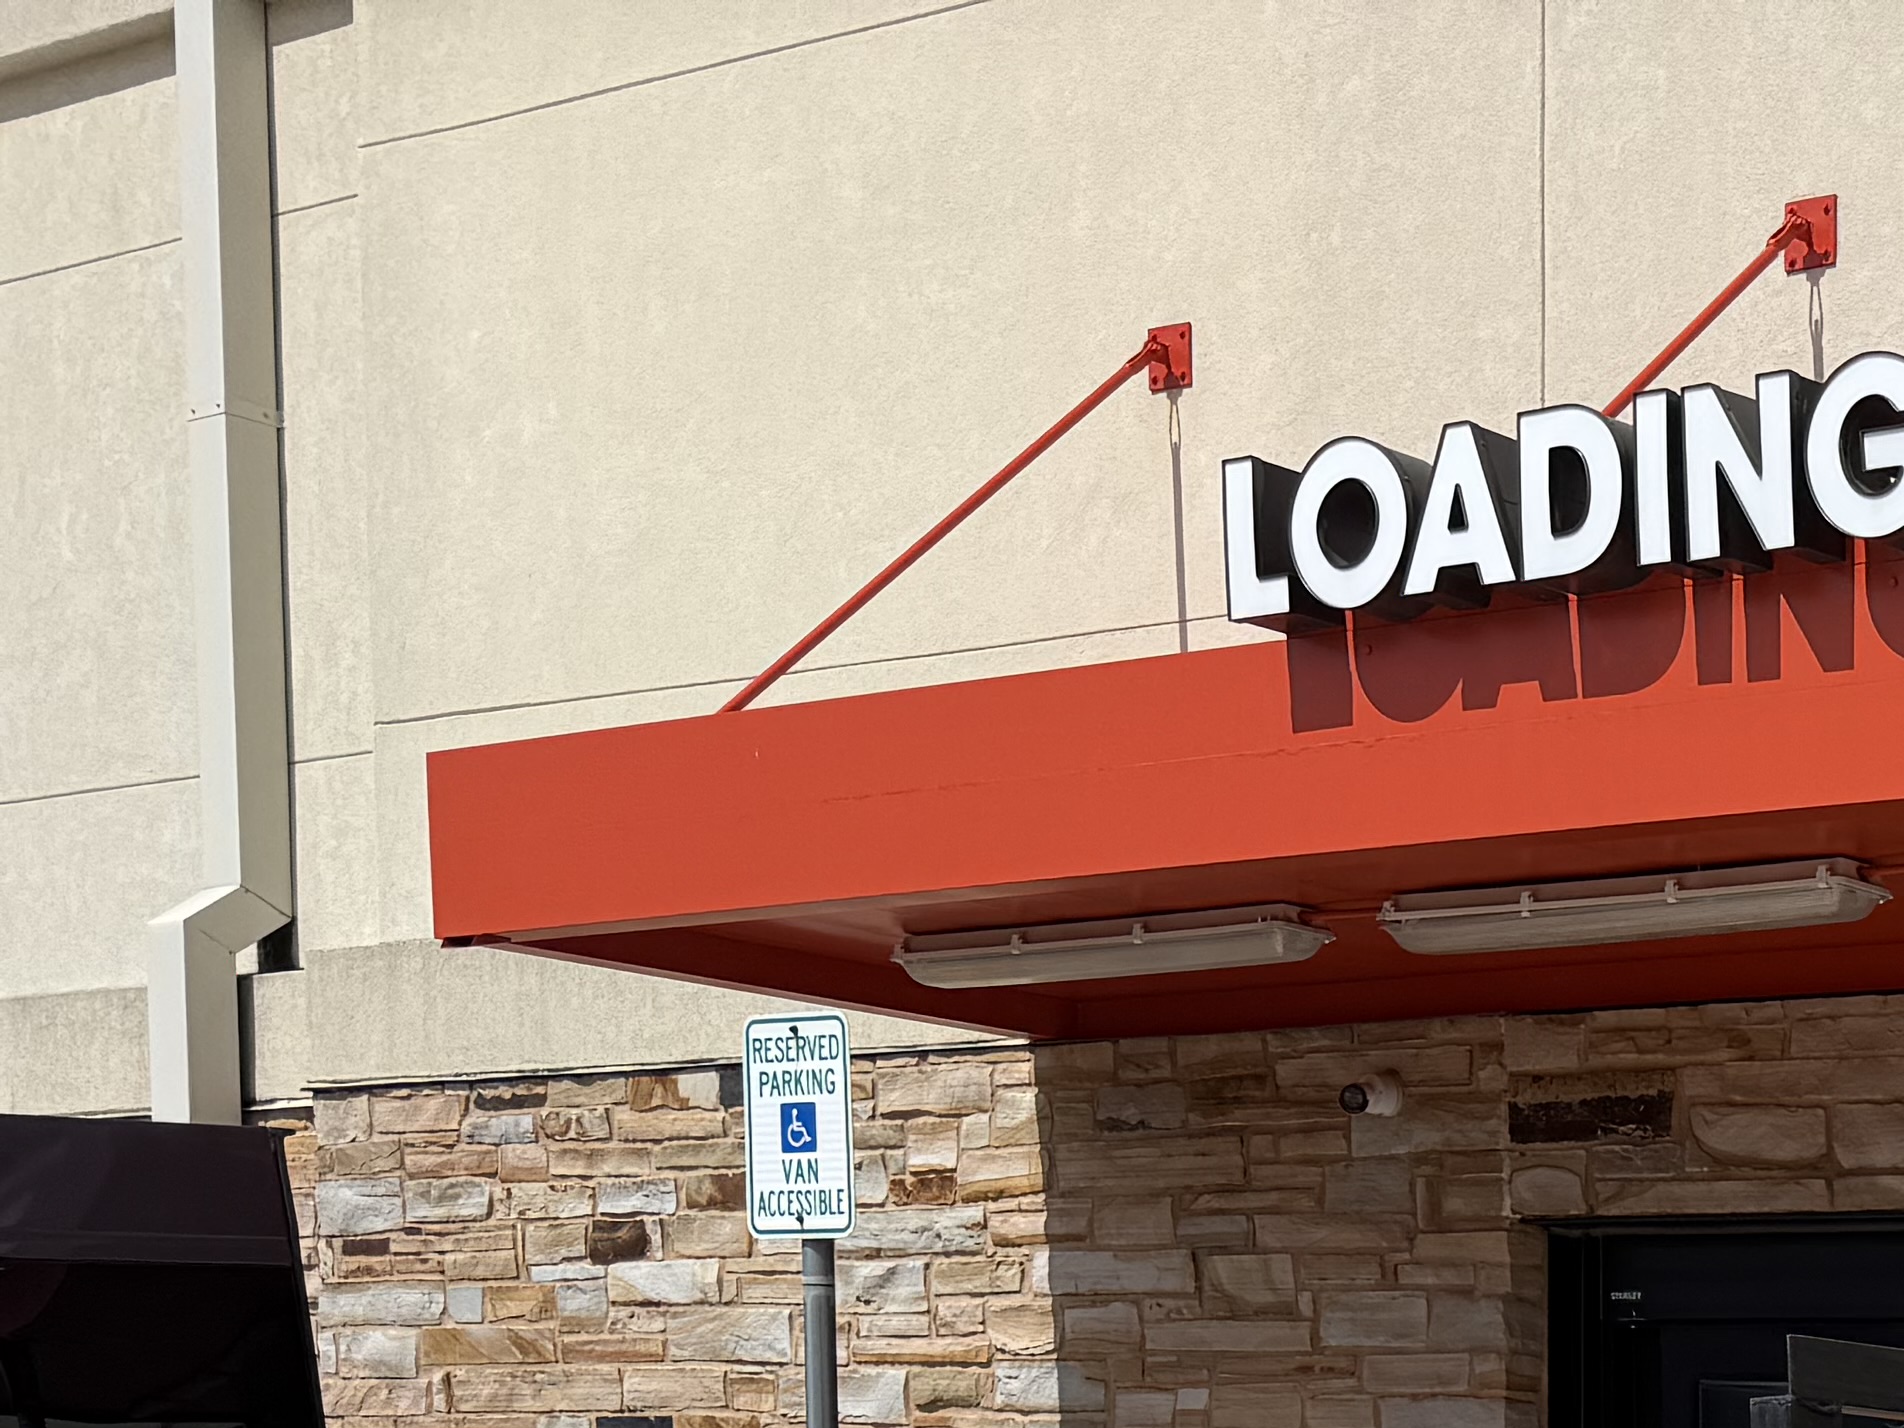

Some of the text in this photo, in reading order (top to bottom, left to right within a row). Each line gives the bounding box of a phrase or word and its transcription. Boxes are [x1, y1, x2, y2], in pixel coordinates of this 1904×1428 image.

[752, 1034, 840, 1064] RESERVED
[759, 1068, 836, 1098] PARKING
[781, 1158, 819, 1185] VAN
[758, 1189, 845, 1217] ACCESSIBLE
